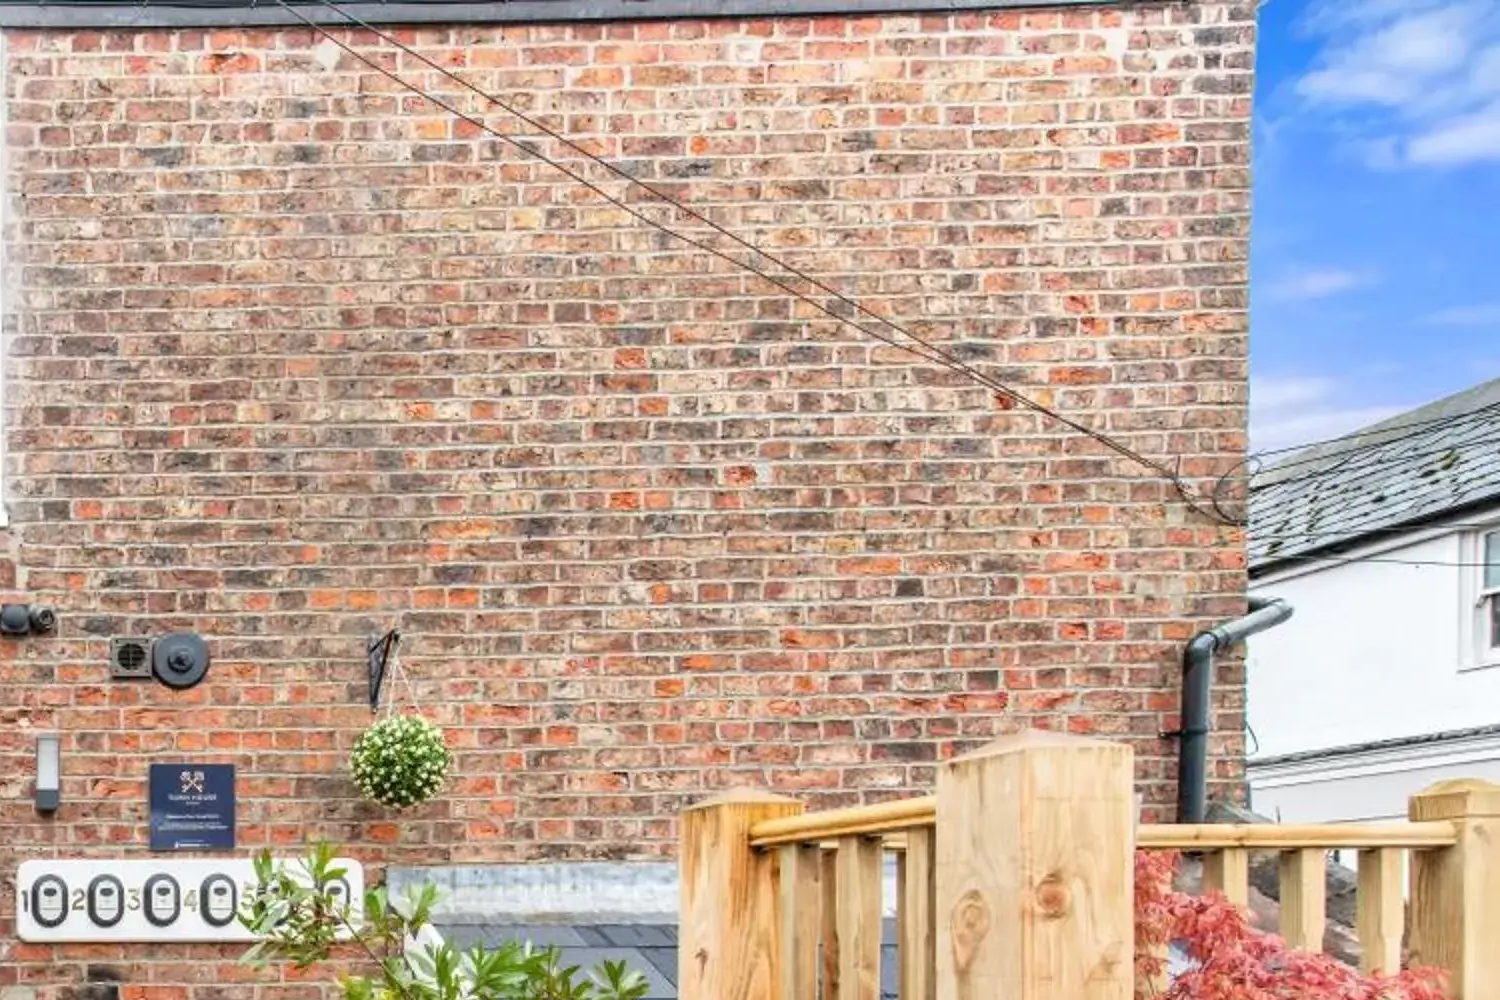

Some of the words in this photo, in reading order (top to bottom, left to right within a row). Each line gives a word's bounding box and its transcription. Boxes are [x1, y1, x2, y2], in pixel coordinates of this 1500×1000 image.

[72, 889, 86, 911] 2
[127, 889, 141, 911] 3
[184, 890, 198, 912] 4
